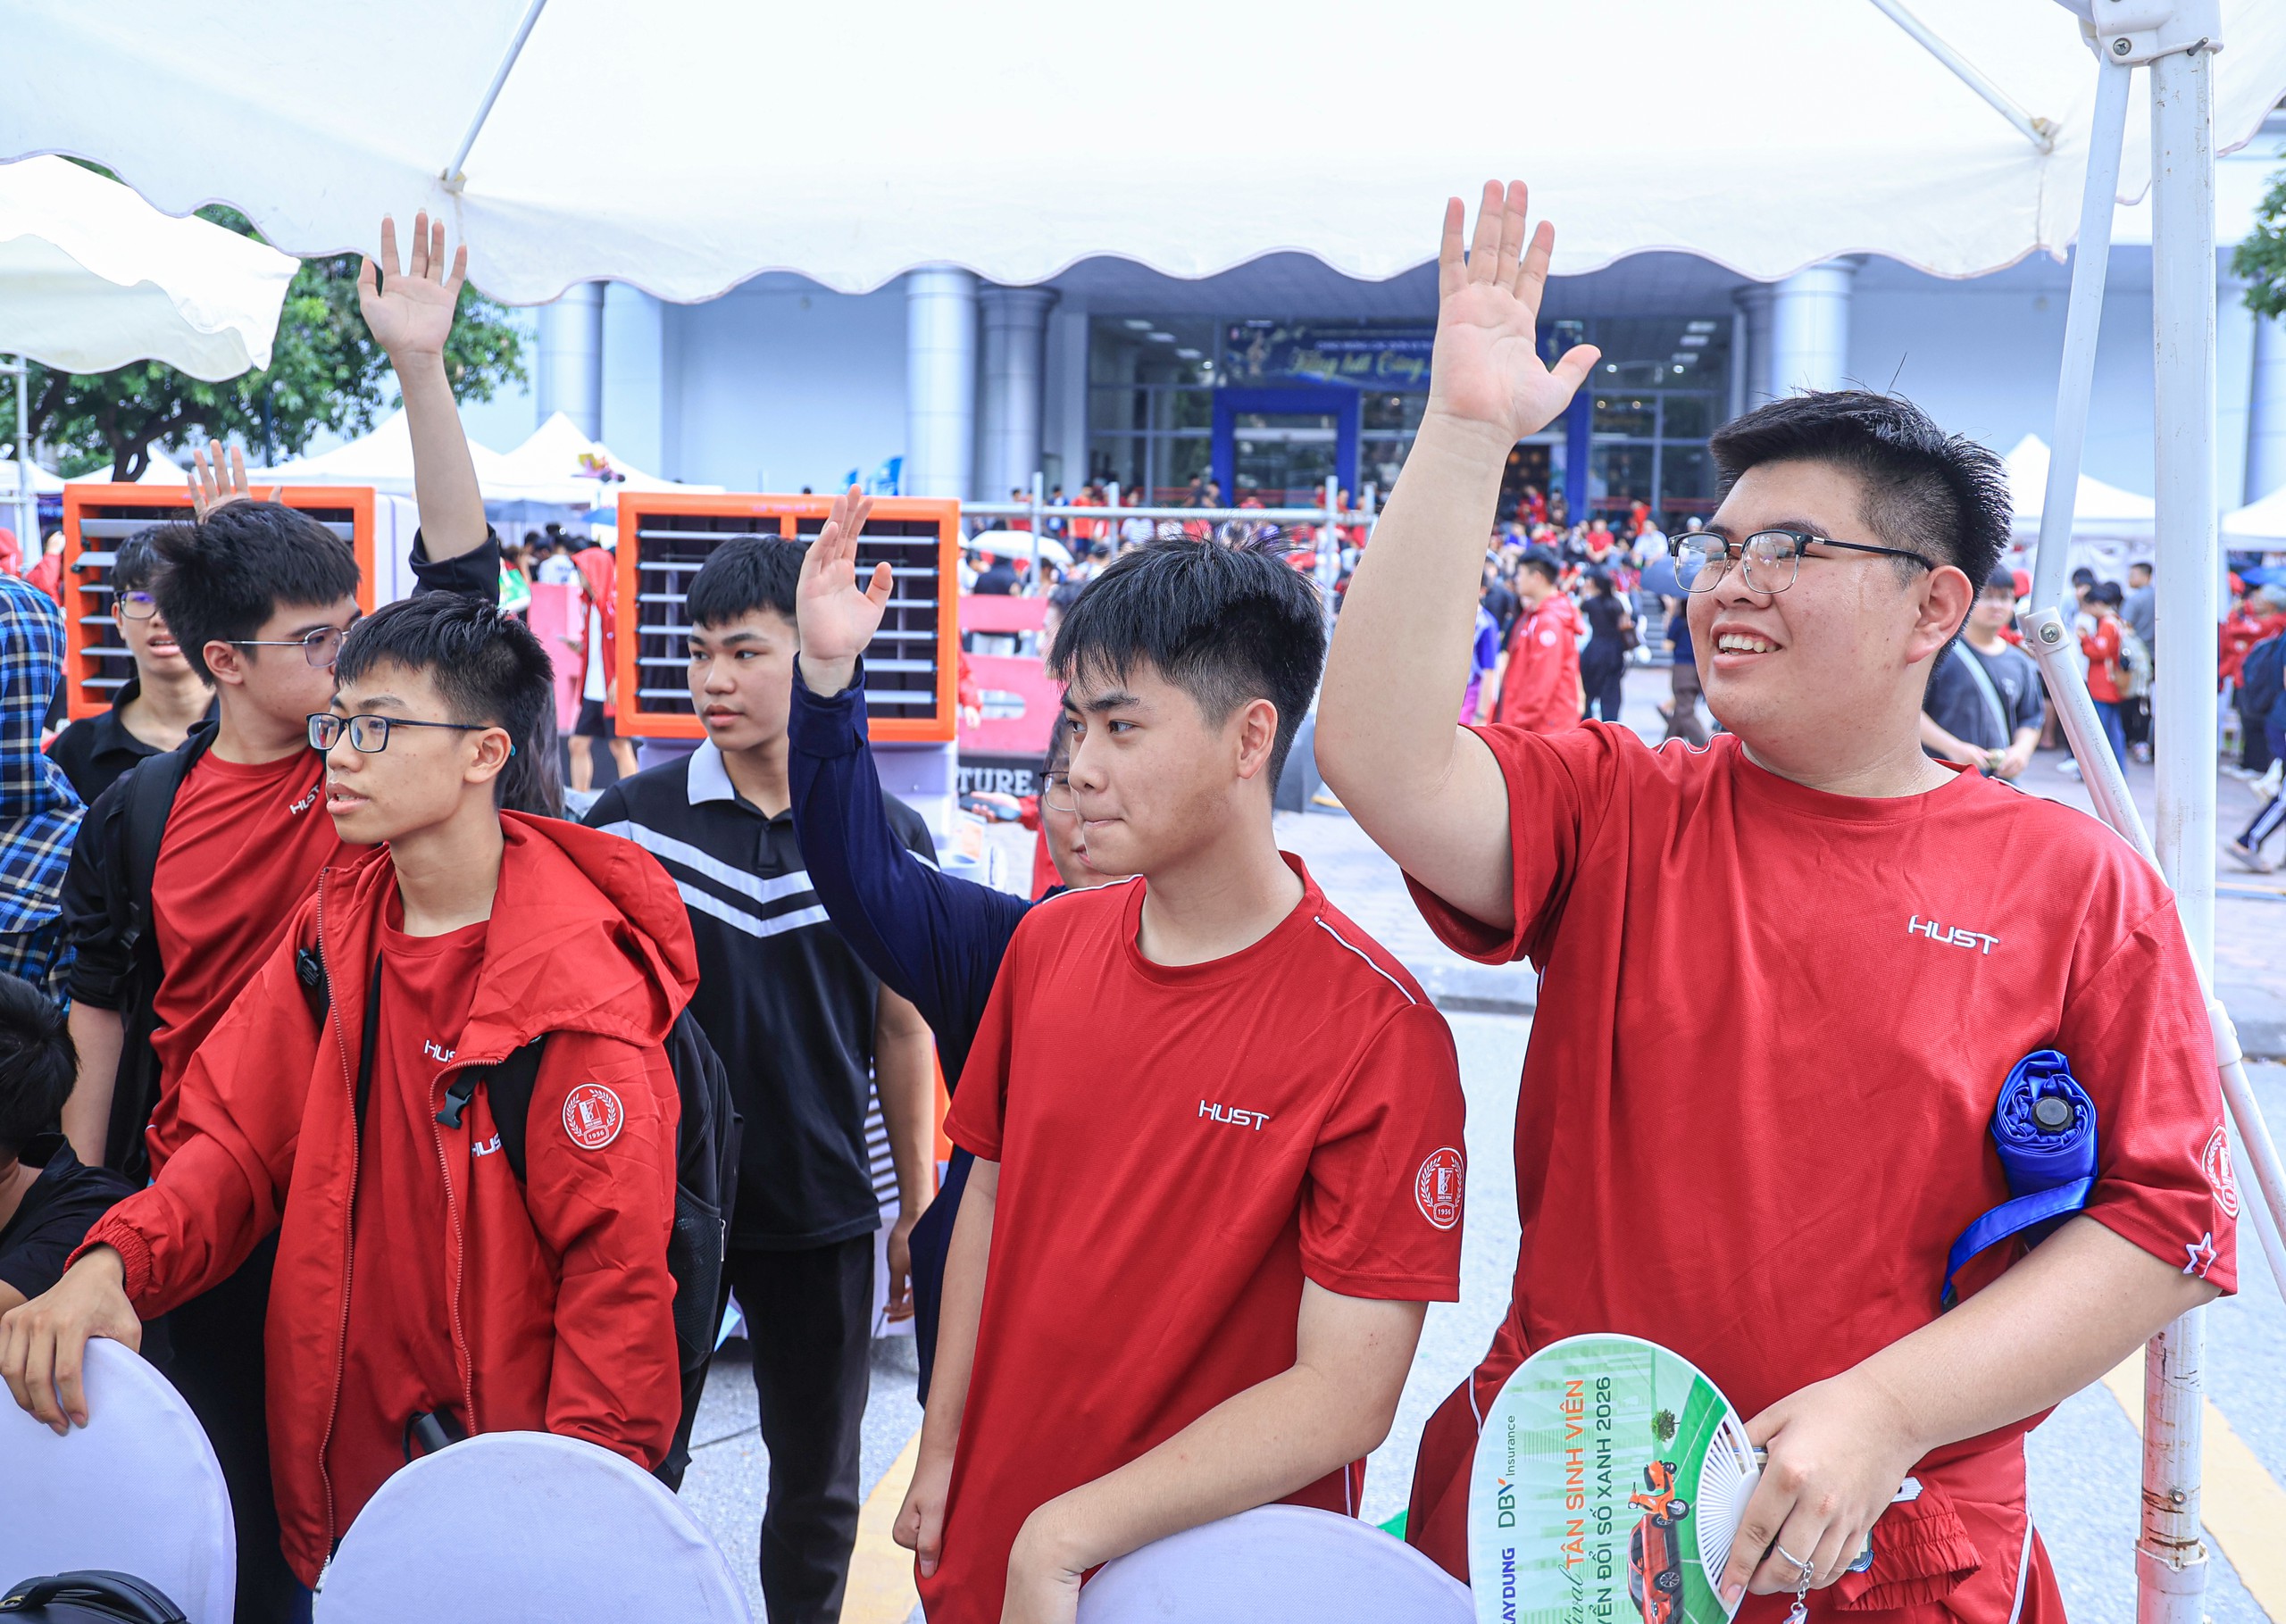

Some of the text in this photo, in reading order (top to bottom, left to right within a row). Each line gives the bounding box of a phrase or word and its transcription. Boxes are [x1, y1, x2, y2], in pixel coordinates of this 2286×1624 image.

[1907, 914, 2000, 954] HUST
[588, 1129, 605, 1140] 1956
[1198, 1099, 1270, 1131] HUST
[1559, 1380, 1584, 1440] VIÊN
[1596, 1376, 1612, 1431] 2026
[1498, 1415, 1515, 1528] DBV Insurance
[1565, 1448, 1585, 1511] SINH
[1597, 1438, 1612, 1499] XANH
[1560, 1519, 1585, 1570] TÂN
[1589, 1505, 1613, 1536] SỐ
[1589, 1543, 1613, 1580] ĐỔI
